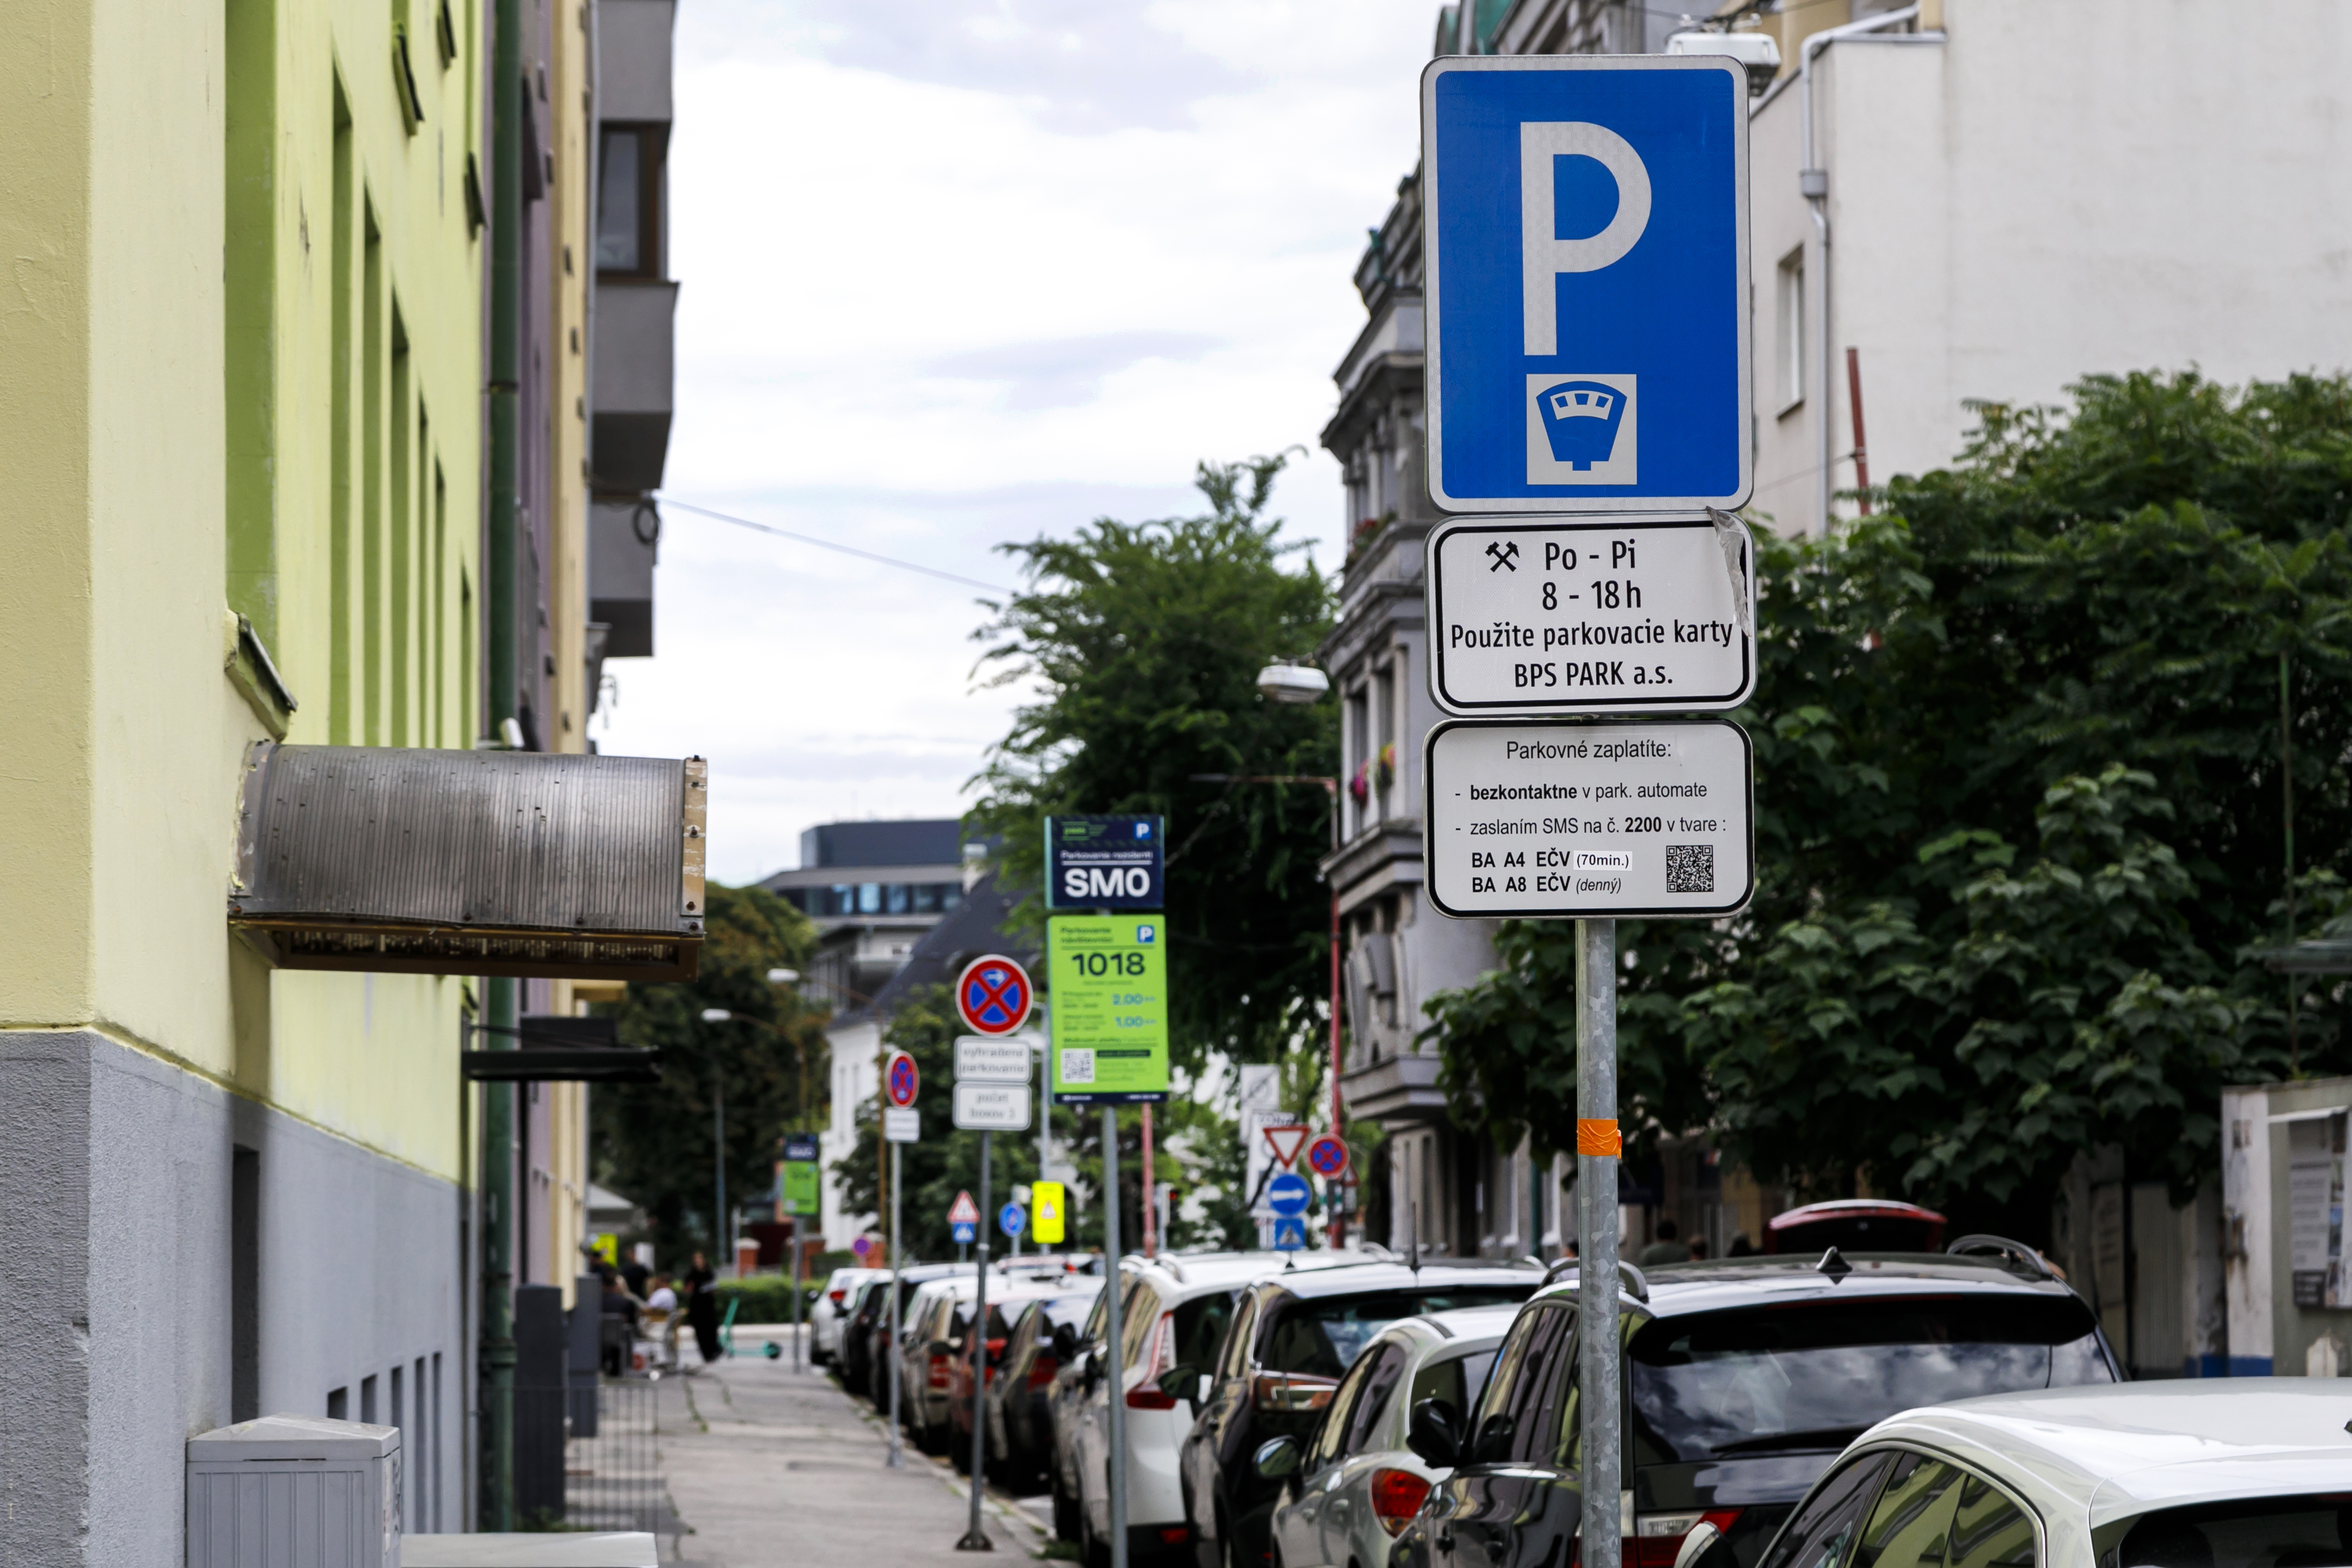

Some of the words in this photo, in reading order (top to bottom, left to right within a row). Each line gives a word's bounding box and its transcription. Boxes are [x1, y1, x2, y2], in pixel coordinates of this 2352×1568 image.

[1520, 121, 1651, 356] P
[1545, 542, 1577, 570] Po
[1612, 538, 1635, 569] Pi
[1542, 582, 1557, 611] 8
[1451, 621, 1534, 649] Použite
[1544, 618, 1665, 652] parkovacie
[1674, 619, 1733, 648] karty
[1515, 663, 1557, 687] BPS
[1567, 661, 1625, 686] PARK
[1634, 666, 1673, 685] a.s.
[1507, 740, 1588, 759] Parkovné
[1593, 739, 1671, 762] zaplatíte:
[1470, 784, 1577, 801] bezkontaktne
[1582, 787, 1591, 799] v
[1596, 782, 1632, 802] park.
[1637, 782, 1707, 798] automate
[1470, 818, 1537, 835] zaslaním
[1543, 817, 1578, 834] SMS
[1584, 821, 1602, 834] na
[1607, 817, 1619, 833] č.
[1625, 817, 1662, 833] 2200
[1667, 820, 1675, 832] v
[1472, 852, 1496, 868] BA
[1503, 851, 1525, 867] A4
[1536, 847, 1570, 867] EČV
[1577, 854, 1629, 869] (70min.)
[1472, 877, 1496, 893] BA
[1505, 876, 1527, 892] A8
[1537, 872, 1571, 892] EČV
[1576, 878, 1621, 895] (denný)
[1071, 951, 1145, 976] 1018
